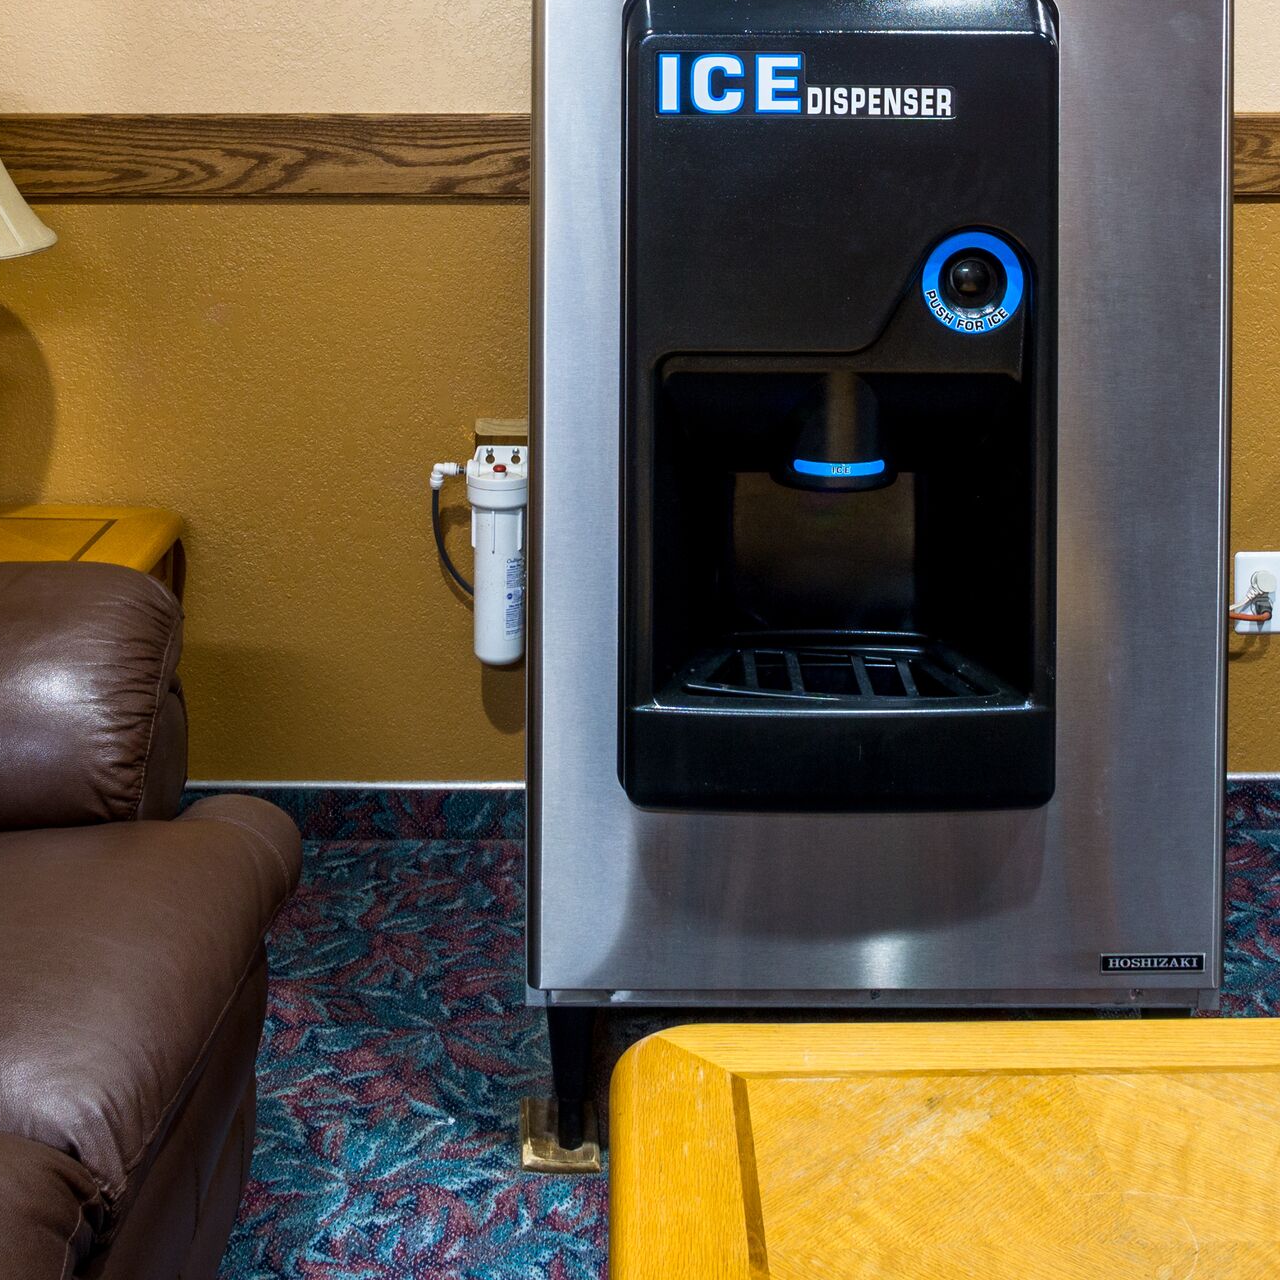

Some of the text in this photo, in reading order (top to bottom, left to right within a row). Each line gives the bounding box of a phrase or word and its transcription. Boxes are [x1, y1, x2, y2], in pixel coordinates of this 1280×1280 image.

[659, 54, 953, 117] ICE DISPENSER
[925, 289, 1010, 332] PUSH FOR ICE
[831, 465, 851, 474] ICE
[1108, 957, 1199, 969] HOSHIZAKI
